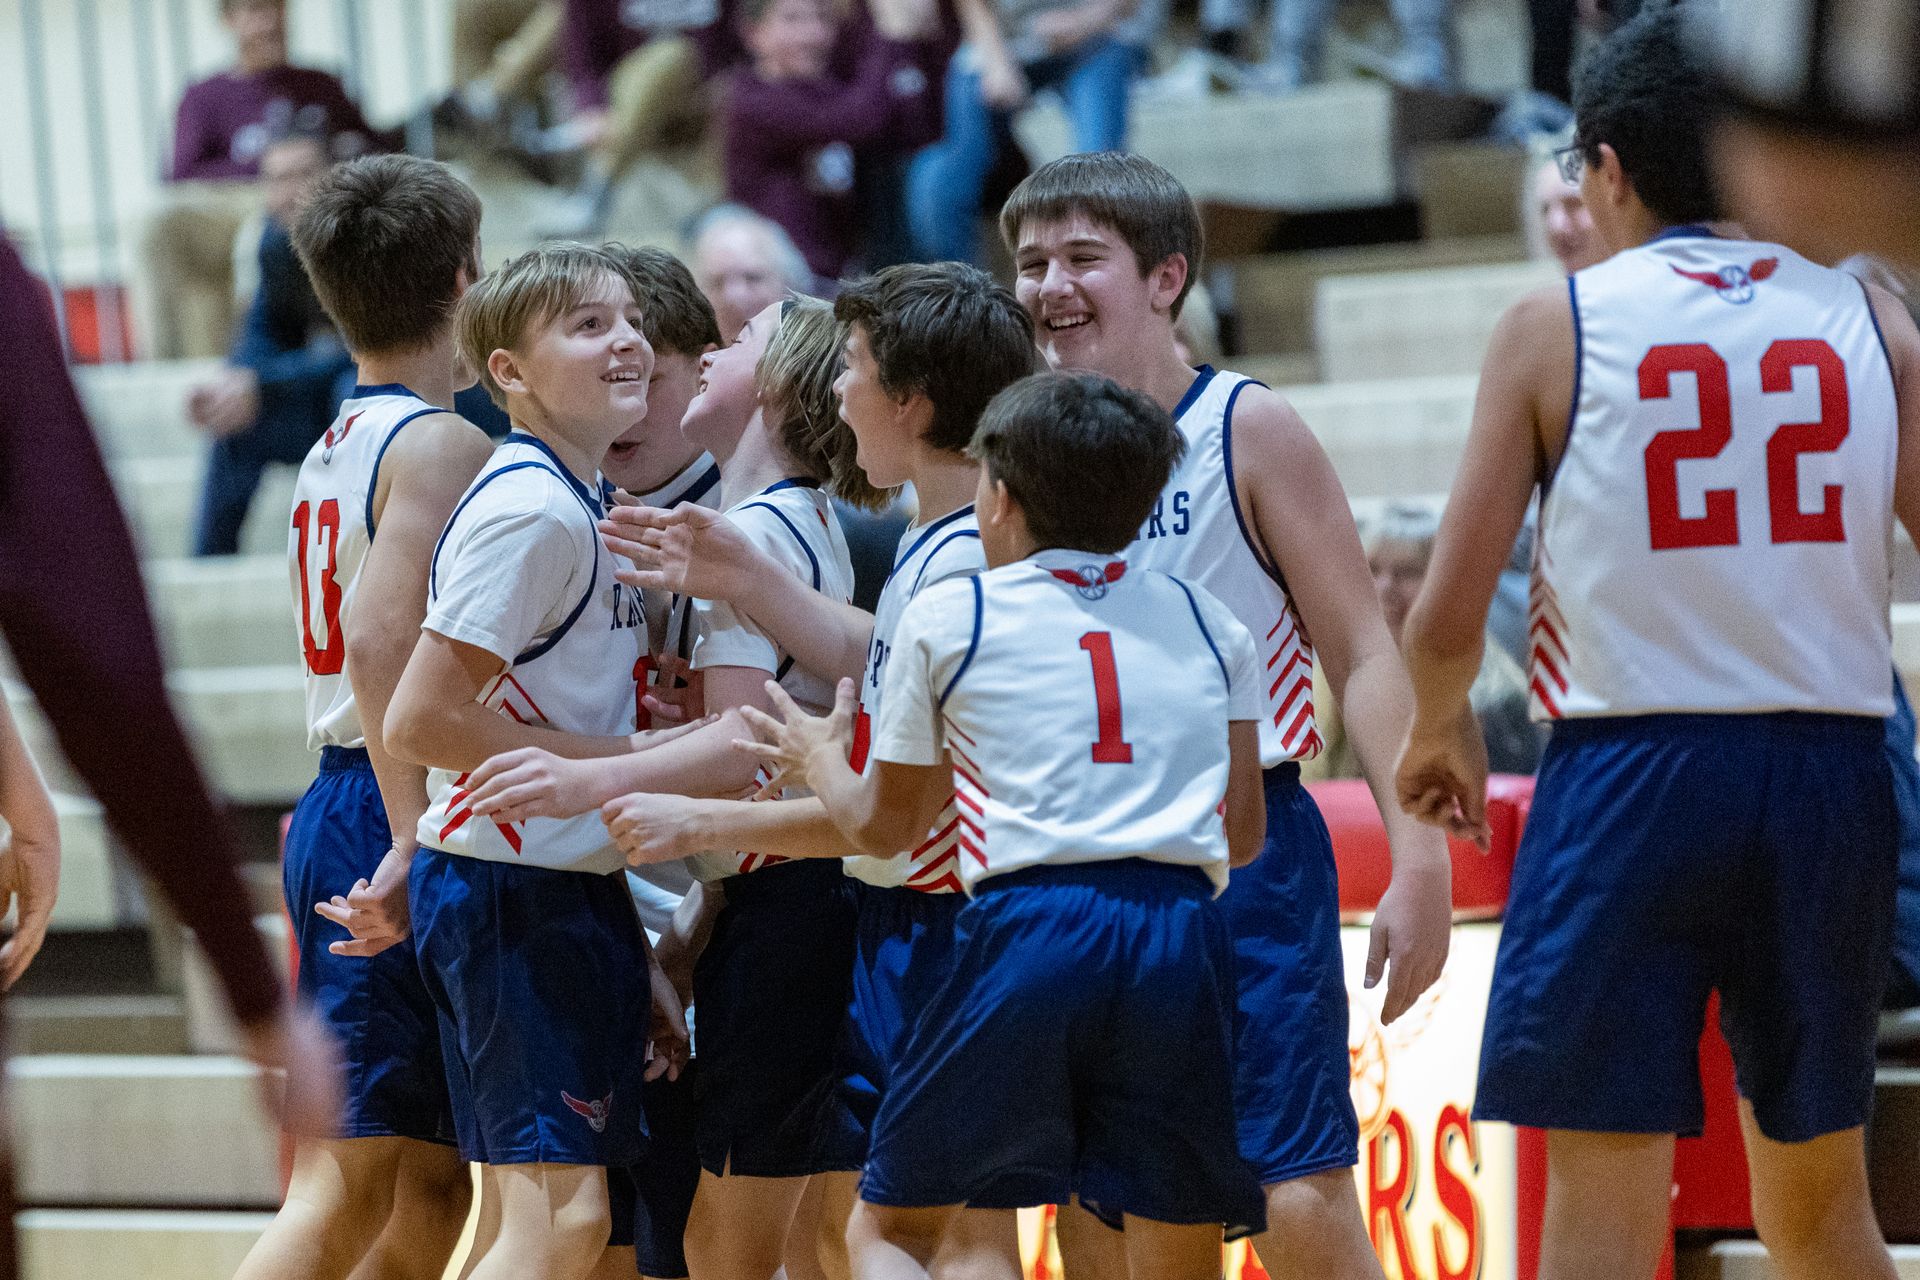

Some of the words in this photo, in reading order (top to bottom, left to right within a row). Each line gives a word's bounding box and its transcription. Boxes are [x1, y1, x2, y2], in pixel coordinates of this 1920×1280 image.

[1137, 490, 1190, 540] RS
[1637, 338, 1849, 550] 22
[293, 498, 345, 676] 13
[1079, 630, 1133, 764] 1
